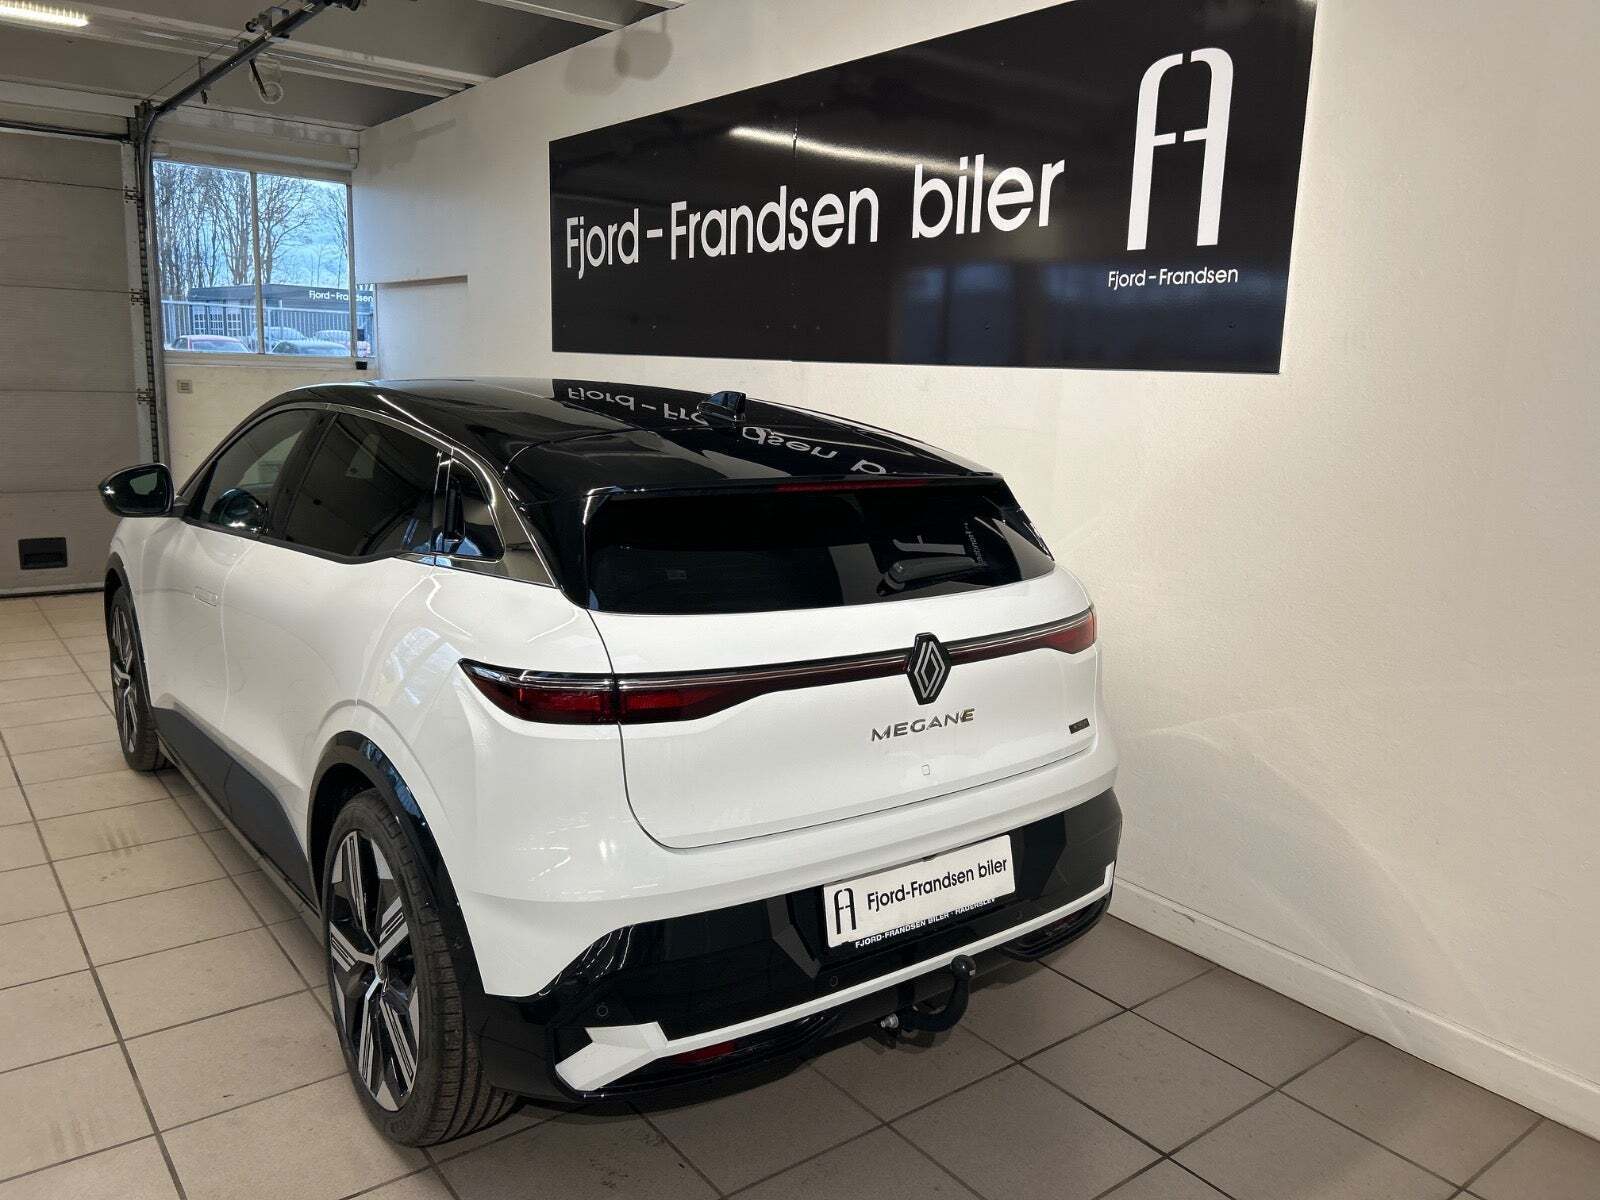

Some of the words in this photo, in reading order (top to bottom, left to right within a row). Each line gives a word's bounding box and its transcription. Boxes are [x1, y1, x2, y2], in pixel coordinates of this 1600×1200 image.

[911, 153, 1066, 239] biler
[871, 707, 976, 742] MEGANE
[866, 867, 975, 913] Fjord-Frandsen
[977, 858, 1008, 879] biler
[854, 919, 927, 949] FJORD-FRANDSEN
[928, 912, 950, 925] BILER
